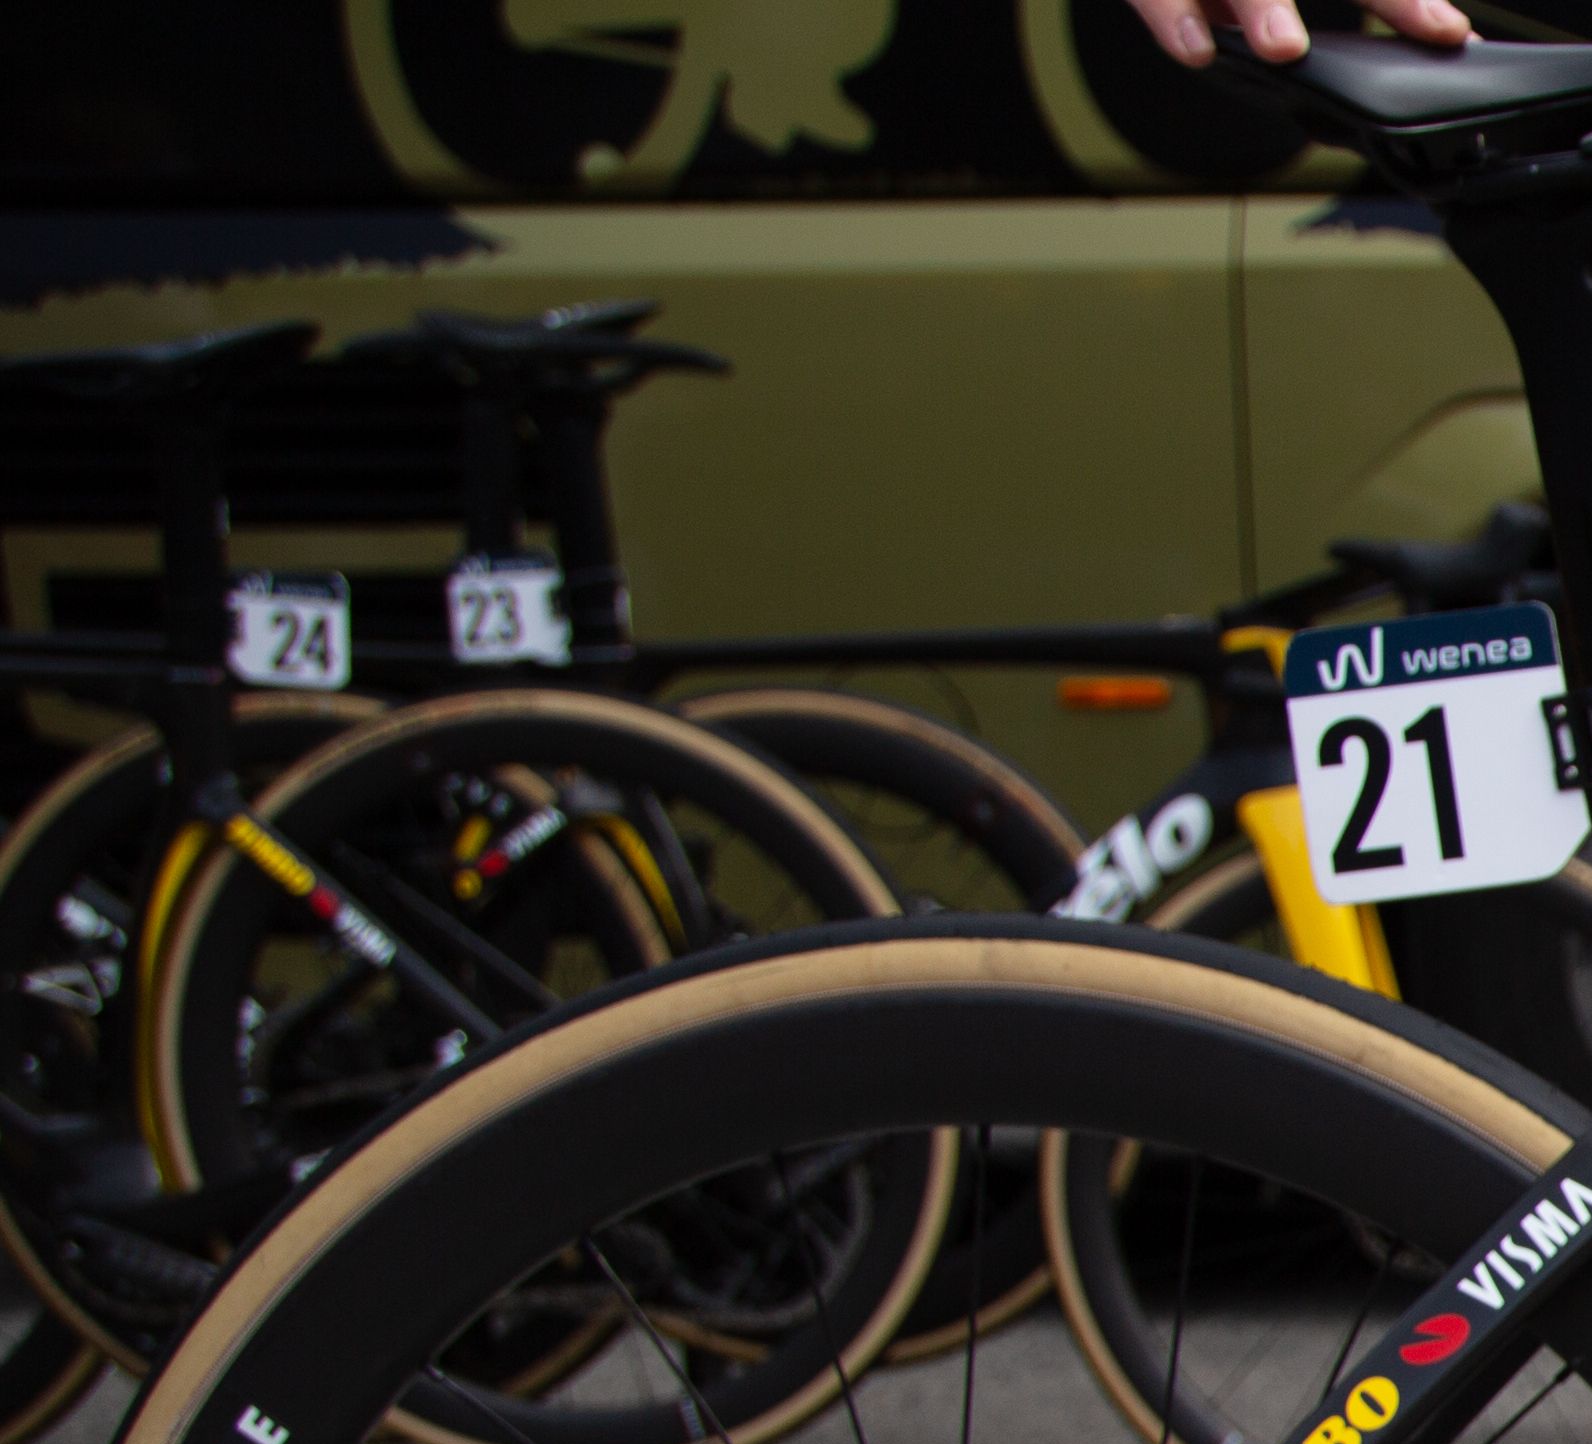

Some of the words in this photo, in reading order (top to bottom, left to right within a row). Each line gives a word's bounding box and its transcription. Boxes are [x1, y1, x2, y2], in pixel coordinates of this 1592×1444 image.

[271, 609, 331, 673] 24
[463, 587, 522, 650] 23
[1402, 636, 1533, 676] wenea
[1319, 704, 1466, 875] 21
